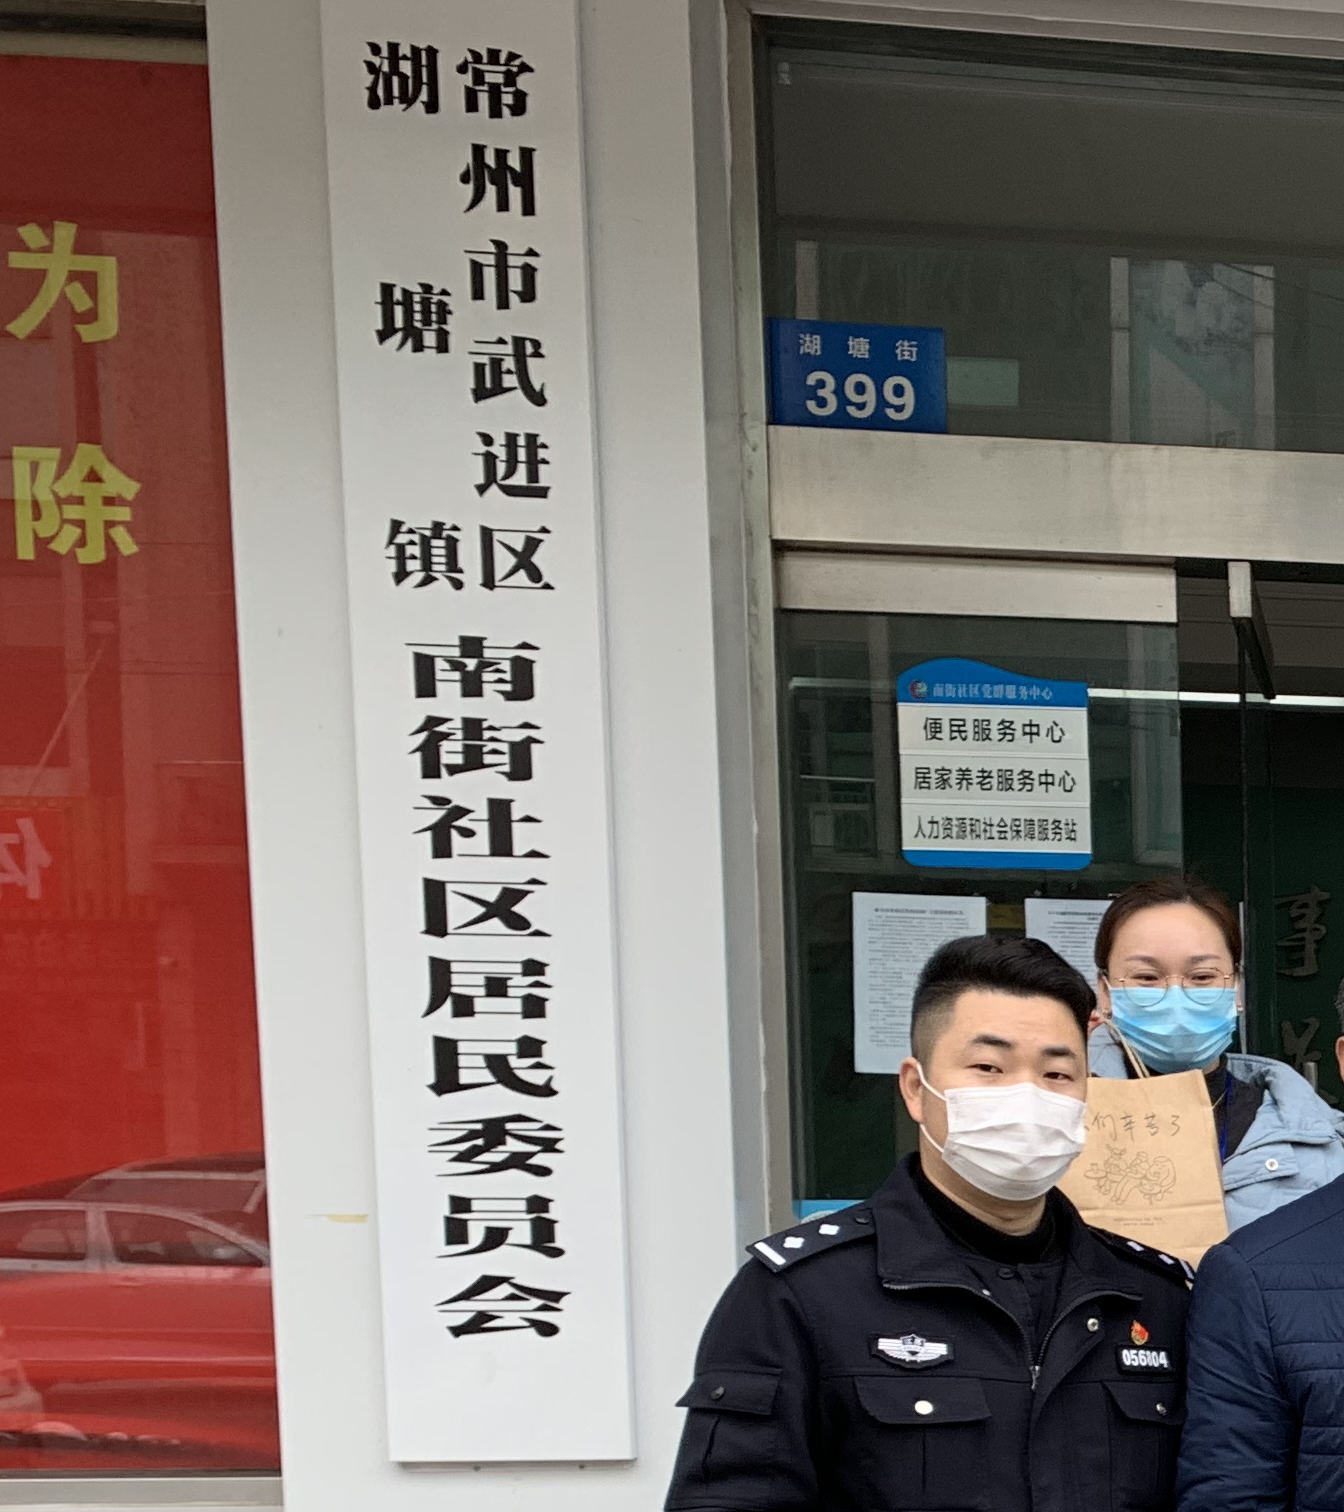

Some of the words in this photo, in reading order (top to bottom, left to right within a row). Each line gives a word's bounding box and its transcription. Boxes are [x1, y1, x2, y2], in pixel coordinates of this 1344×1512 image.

[6, 221, 120, 344] 为
[364, 41, 466, 591] 湖塘镇
[455, 47, 556, 592] 常州市武进区
[799, 332, 918, 362] 湖塘街
[804, 370, 917, 421] 399
[12, 445, 141, 565] 除
[922, 717, 1066, 744] 便民服务中心
[913, 766, 1077, 794] 居家养老服务中心
[913, 815, 1078, 842] 人力资源和社会保障服务站
[404, 634, 571, 1339] 南街社区居民委员会
[1084, 1111, 1181, 1141] 们辛苦了
